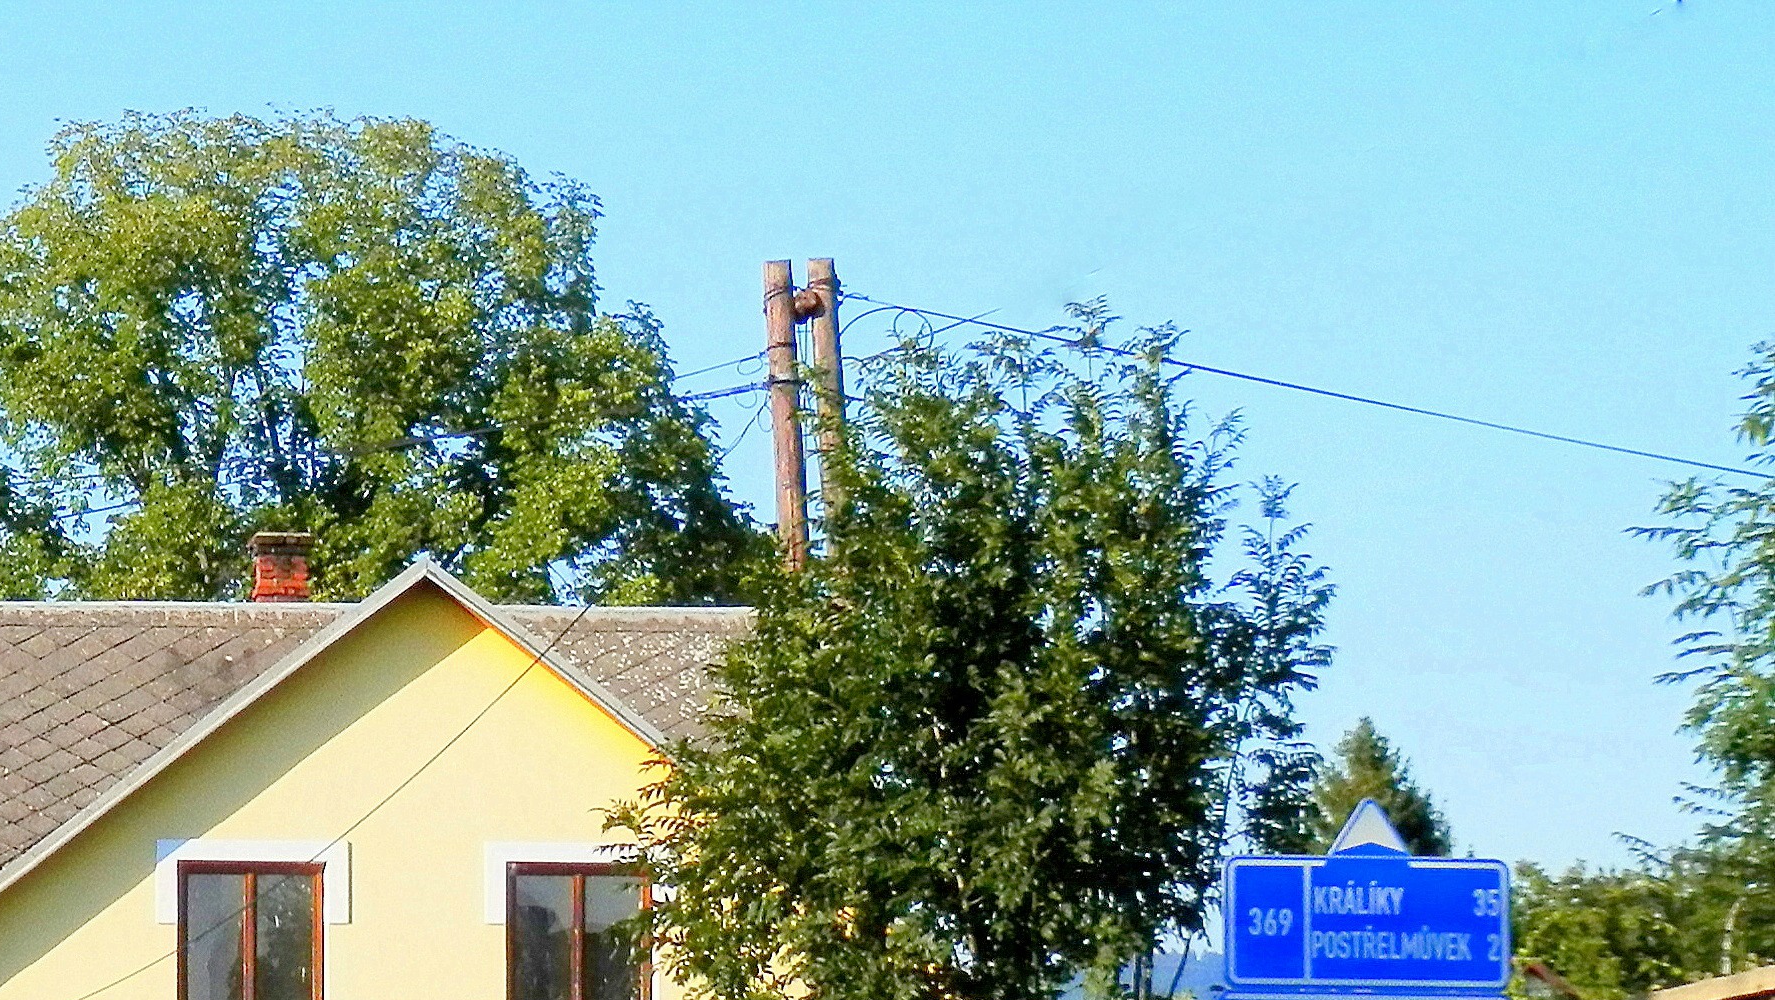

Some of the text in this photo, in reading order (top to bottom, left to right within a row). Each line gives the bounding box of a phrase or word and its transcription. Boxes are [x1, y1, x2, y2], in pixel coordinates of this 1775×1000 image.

[1313, 881, 1500, 917] KRÁLÍKY 35
[1249, 908, 1294, 936] 369
[1311, 925, 1501, 962] POSTŘELMŮVEK 2
